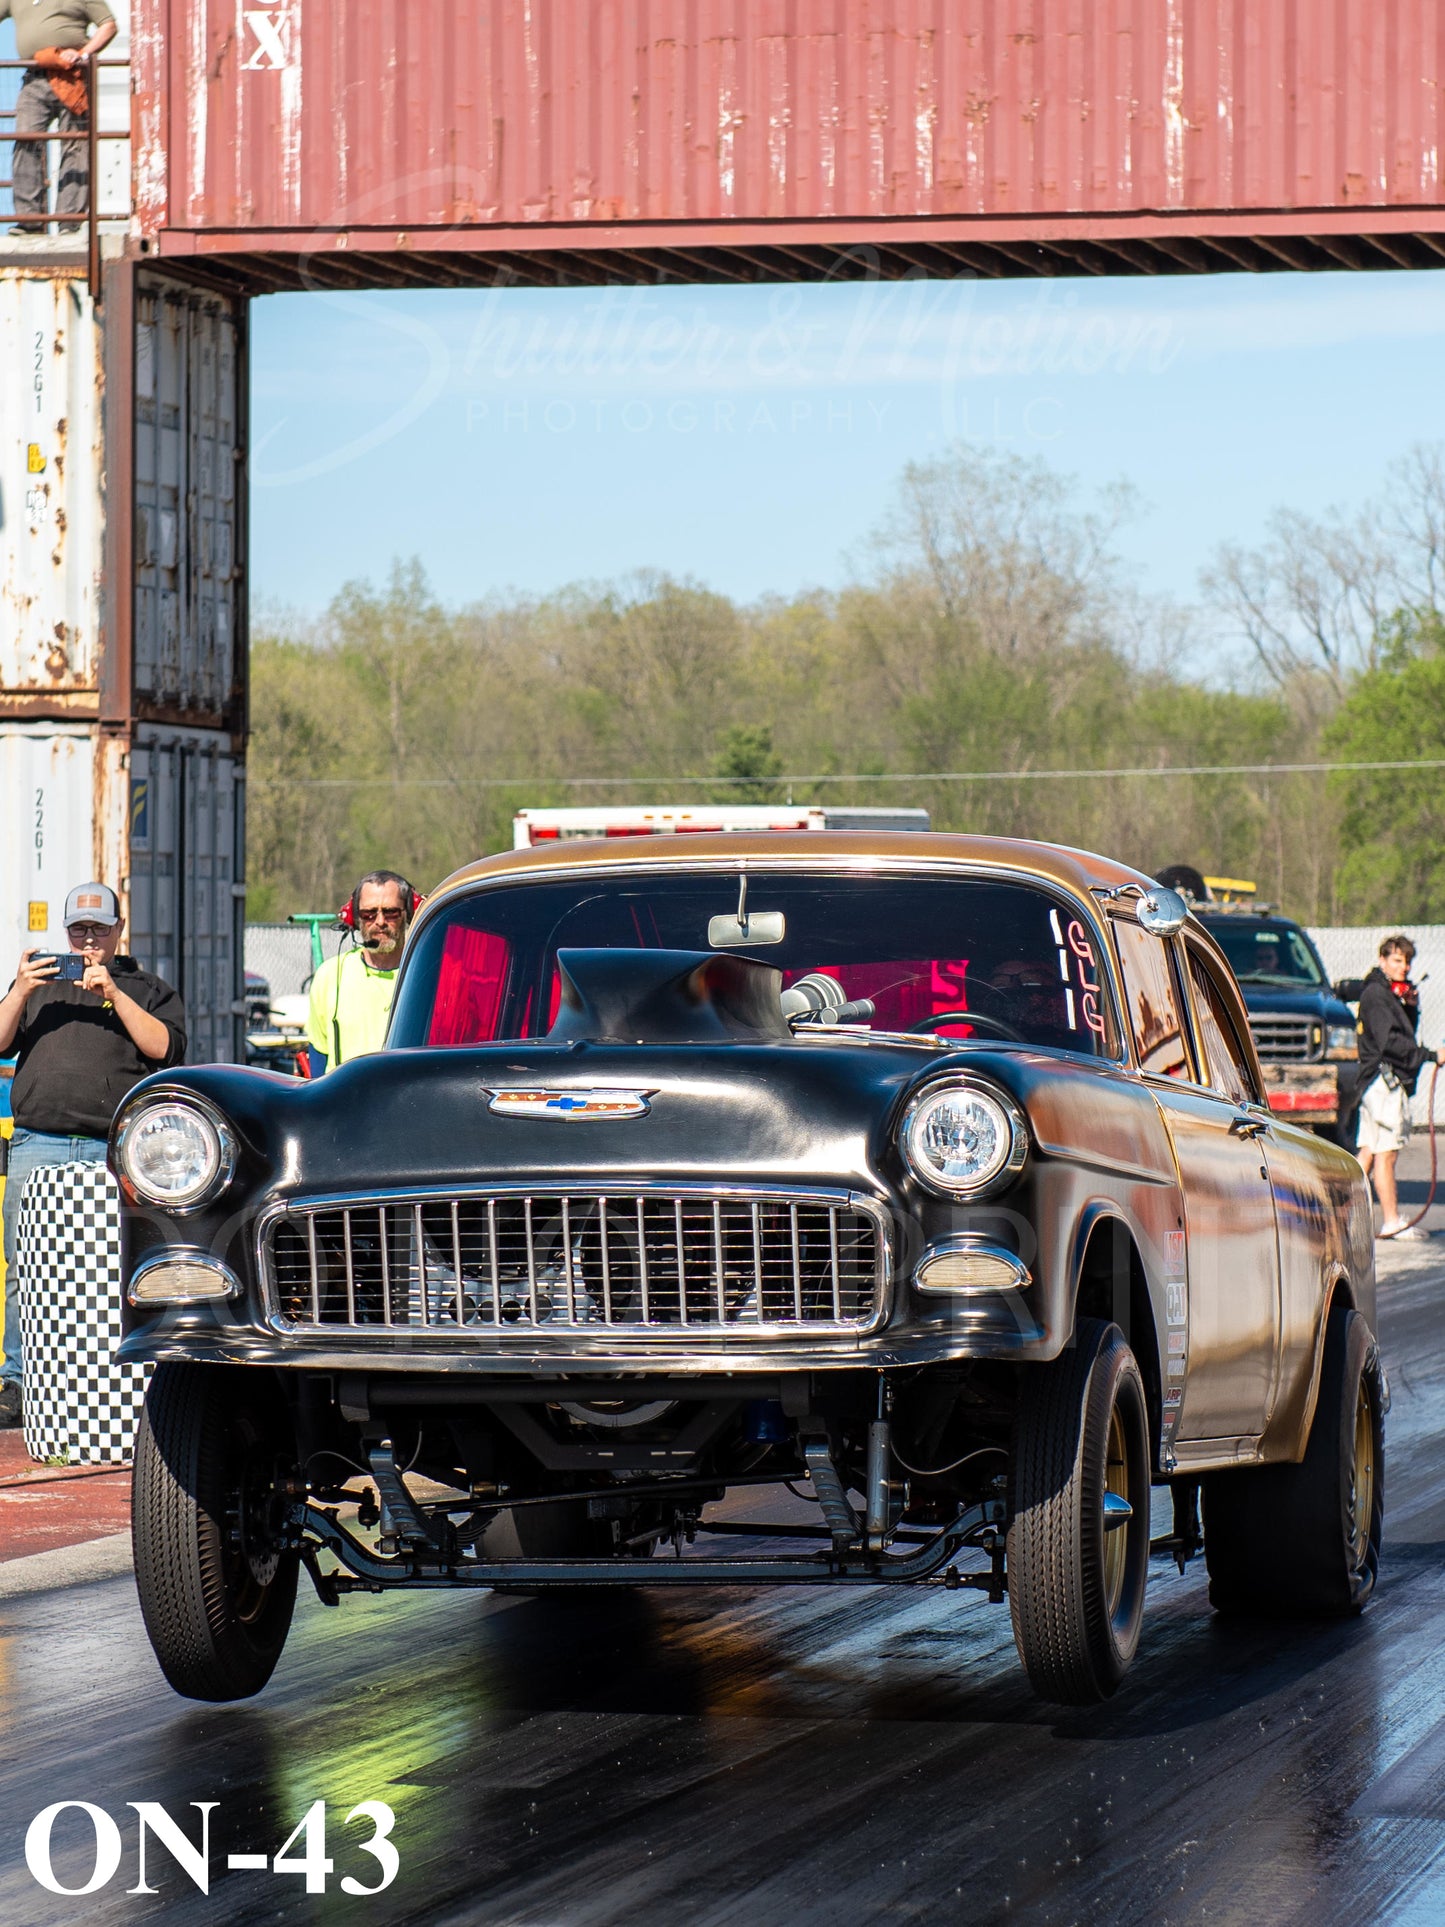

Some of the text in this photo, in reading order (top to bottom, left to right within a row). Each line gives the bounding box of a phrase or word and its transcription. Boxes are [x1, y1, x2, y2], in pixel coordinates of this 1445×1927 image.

[34, 330, 44, 413] 22G1
[35, 787, 44, 871] 22G1
[1165, 1388, 1181, 1401] ARP
